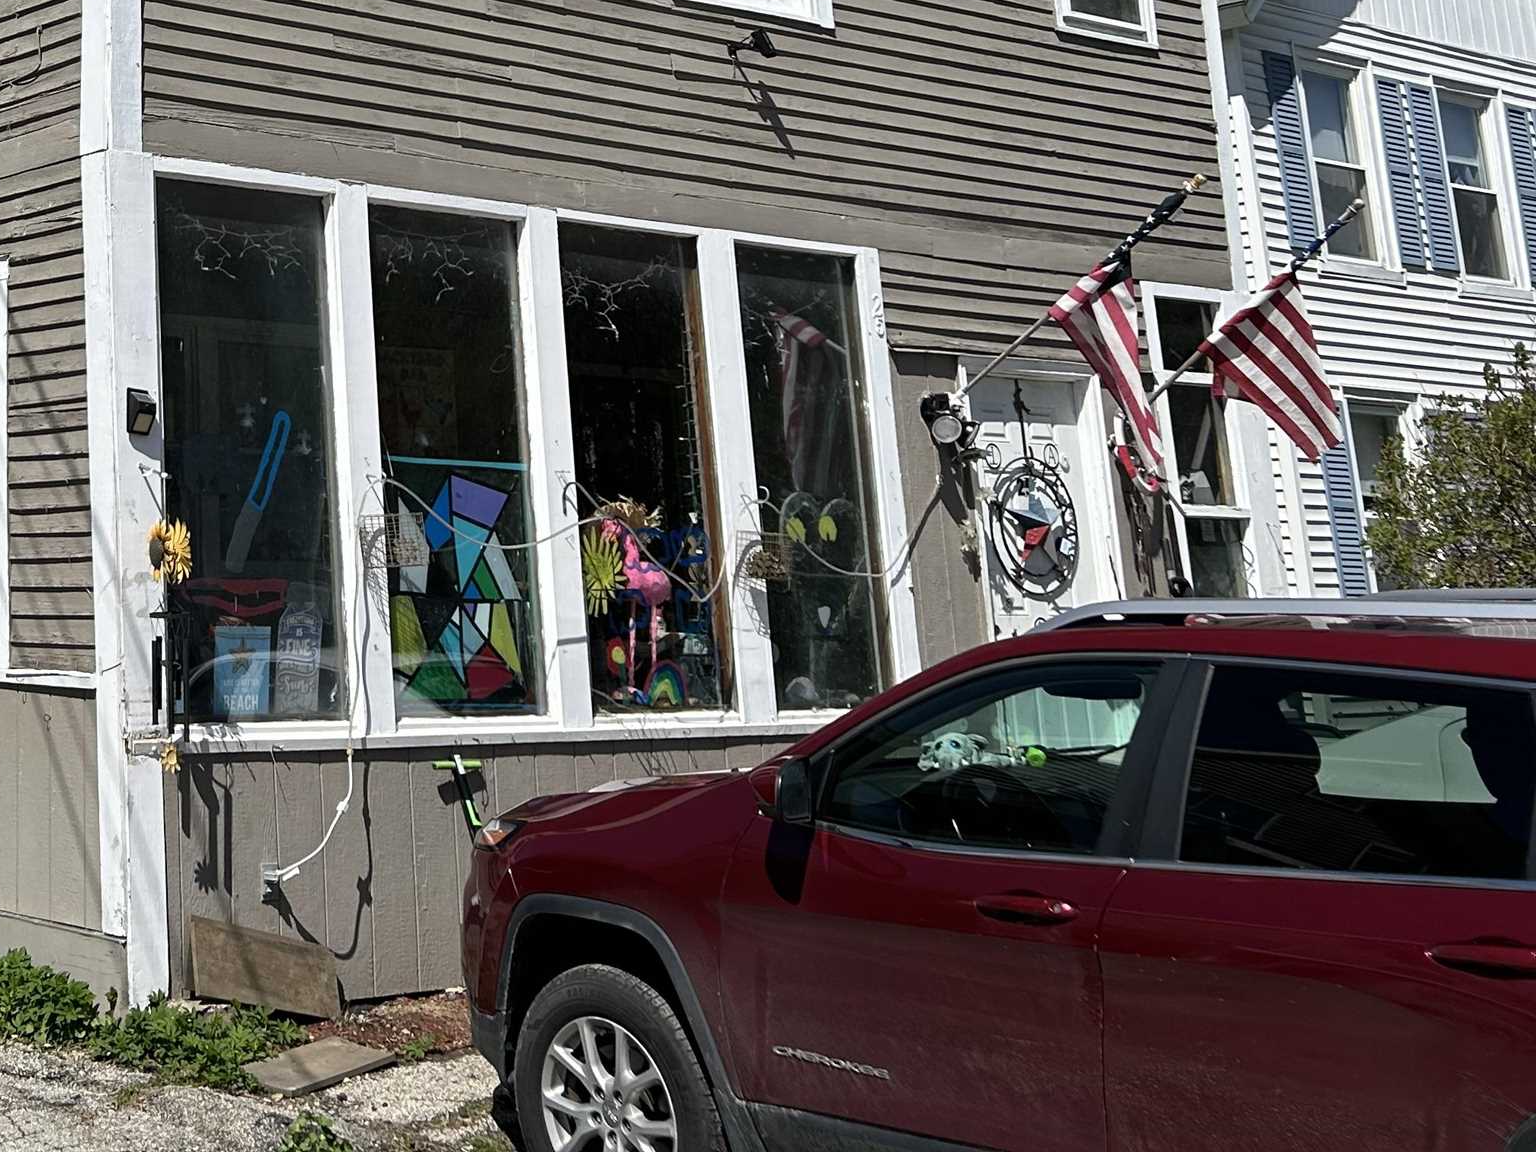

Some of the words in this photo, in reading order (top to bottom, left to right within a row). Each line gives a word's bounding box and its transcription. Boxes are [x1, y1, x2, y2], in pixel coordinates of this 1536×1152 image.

[285, 639, 312, 657] FINE
[223, 694, 259, 711] BEACH
[772, 1045, 890, 1080] CHEROKEE
